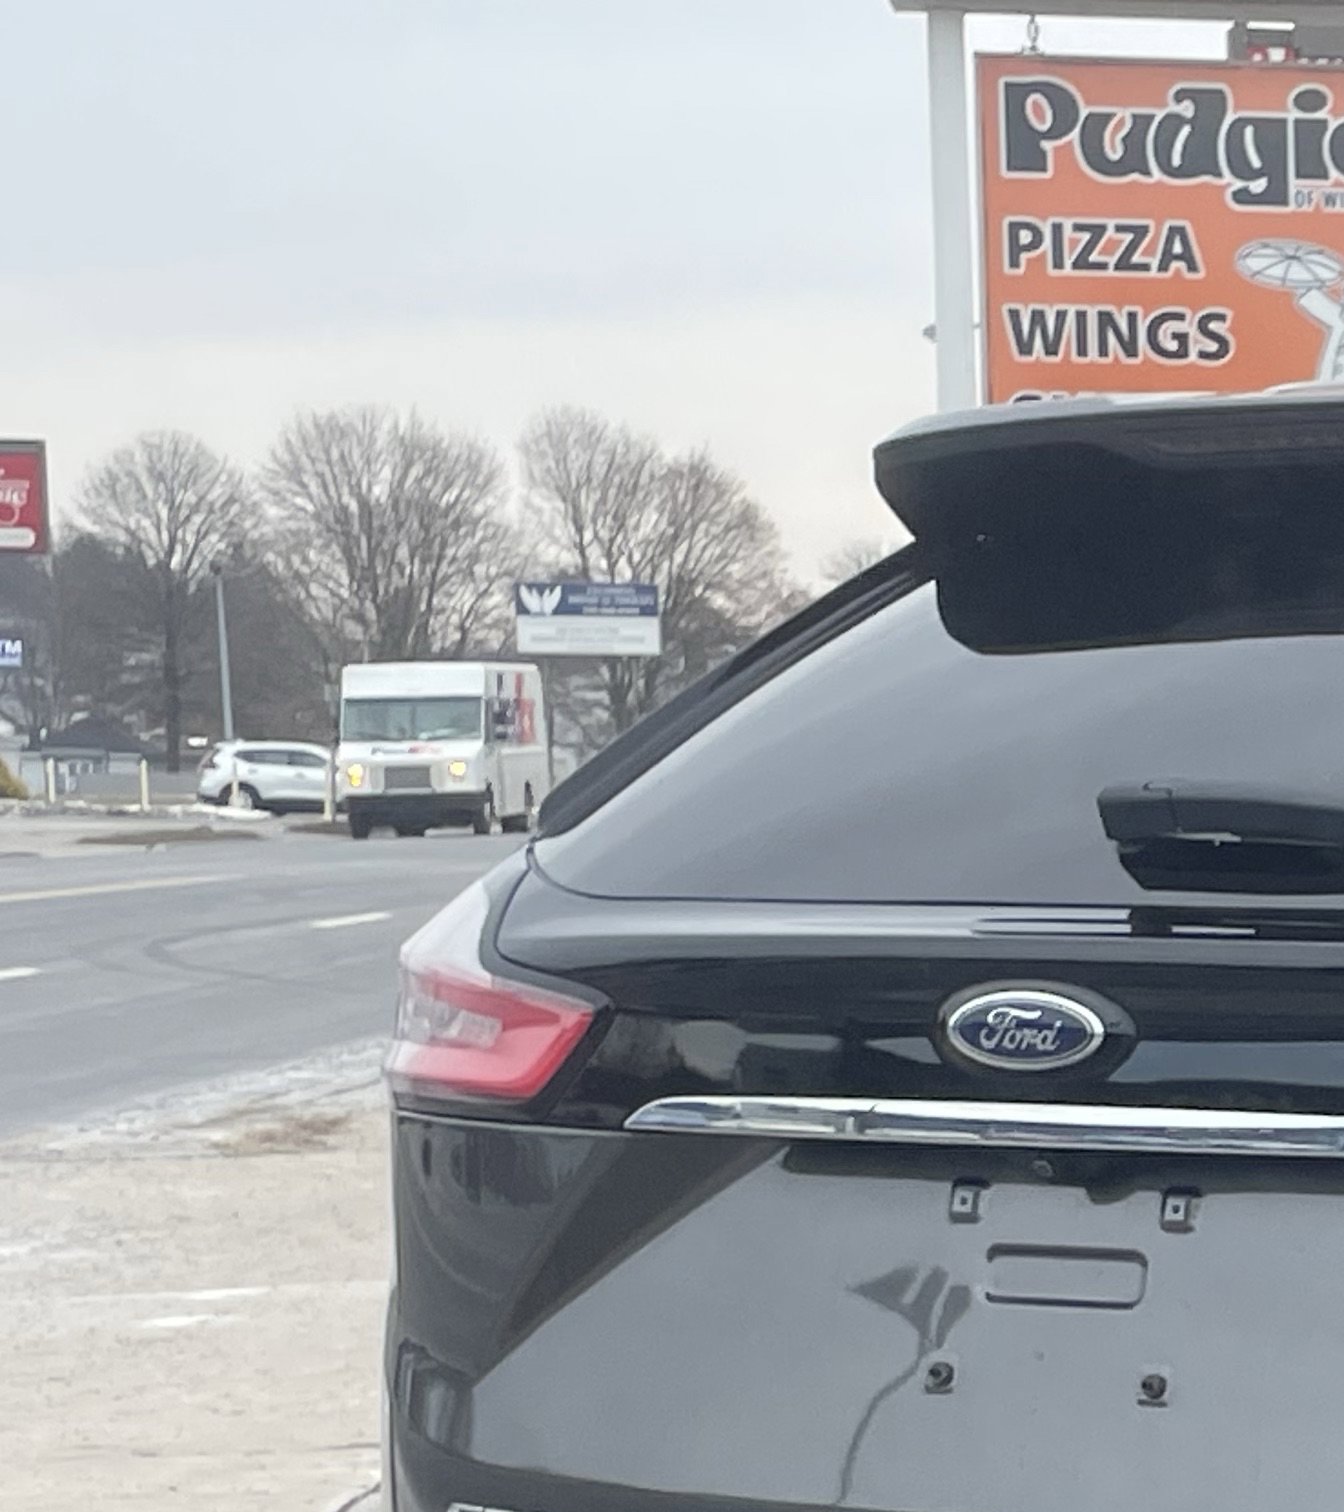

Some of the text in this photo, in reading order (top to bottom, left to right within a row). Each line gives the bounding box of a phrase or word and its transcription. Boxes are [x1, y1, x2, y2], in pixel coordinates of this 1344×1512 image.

[1007, 223, 1199, 274] PIZZA
[1007, 310, 1231, 361] WINGS
[979, 1007, 1062, 1050] Ford
